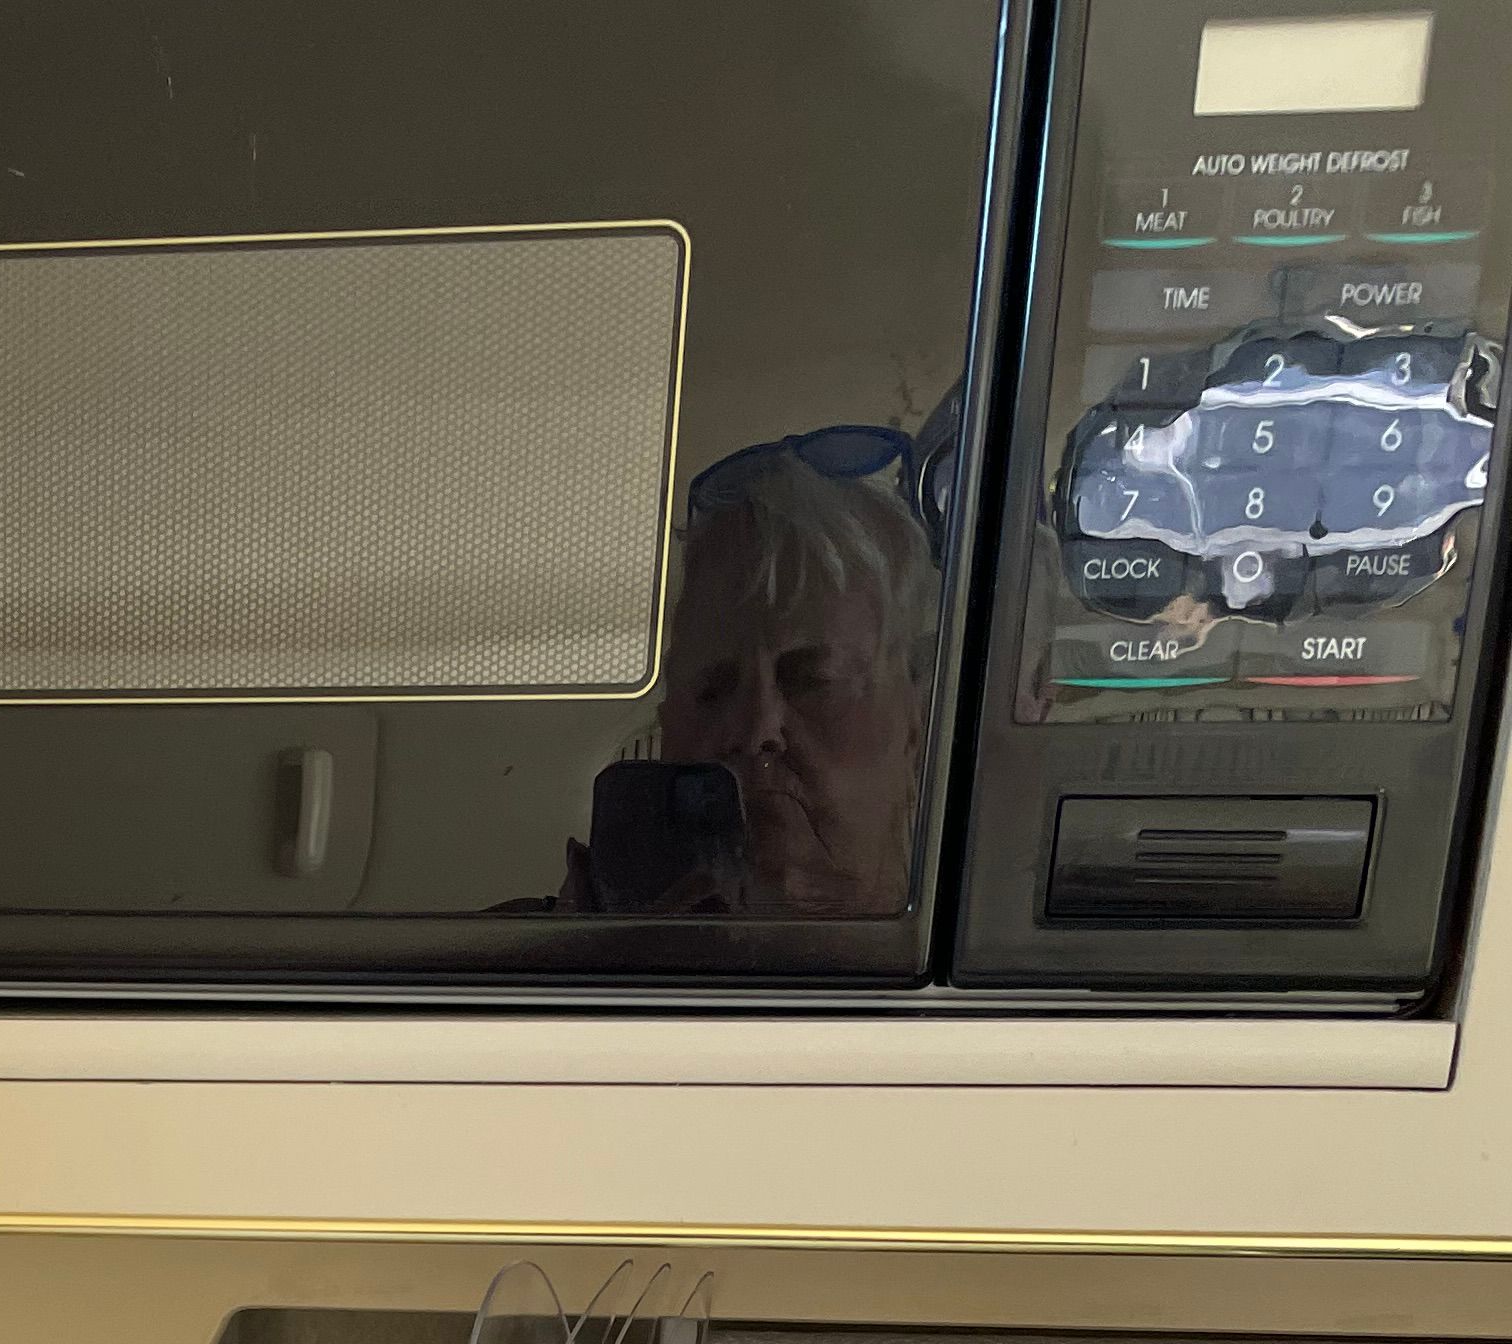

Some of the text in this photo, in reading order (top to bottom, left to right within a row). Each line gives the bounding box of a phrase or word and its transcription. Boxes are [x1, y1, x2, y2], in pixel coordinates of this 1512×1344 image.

[1192, 149, 1410, 177] AUTO WEIGHT DEFROST
[1161, 187, 1168, 208] 1
[1290, 184, 1304, 206] 2
[1135, 205, 1442, 232] MEAT POULTRY FISH
[1163, 282, 1423, 310] TIME POWER
[1138, 352, 1412, 391] 1 2 3
[1123, 418, 1403, 454] 4 5 6
[1119, 484, 1394, 522] 7 8 9
[1083, 558, 1162, 580] CLOCK
[1345, 554, 1412, 577] PAUSE
[1109, 636, 1367, 661] CLEAR START
